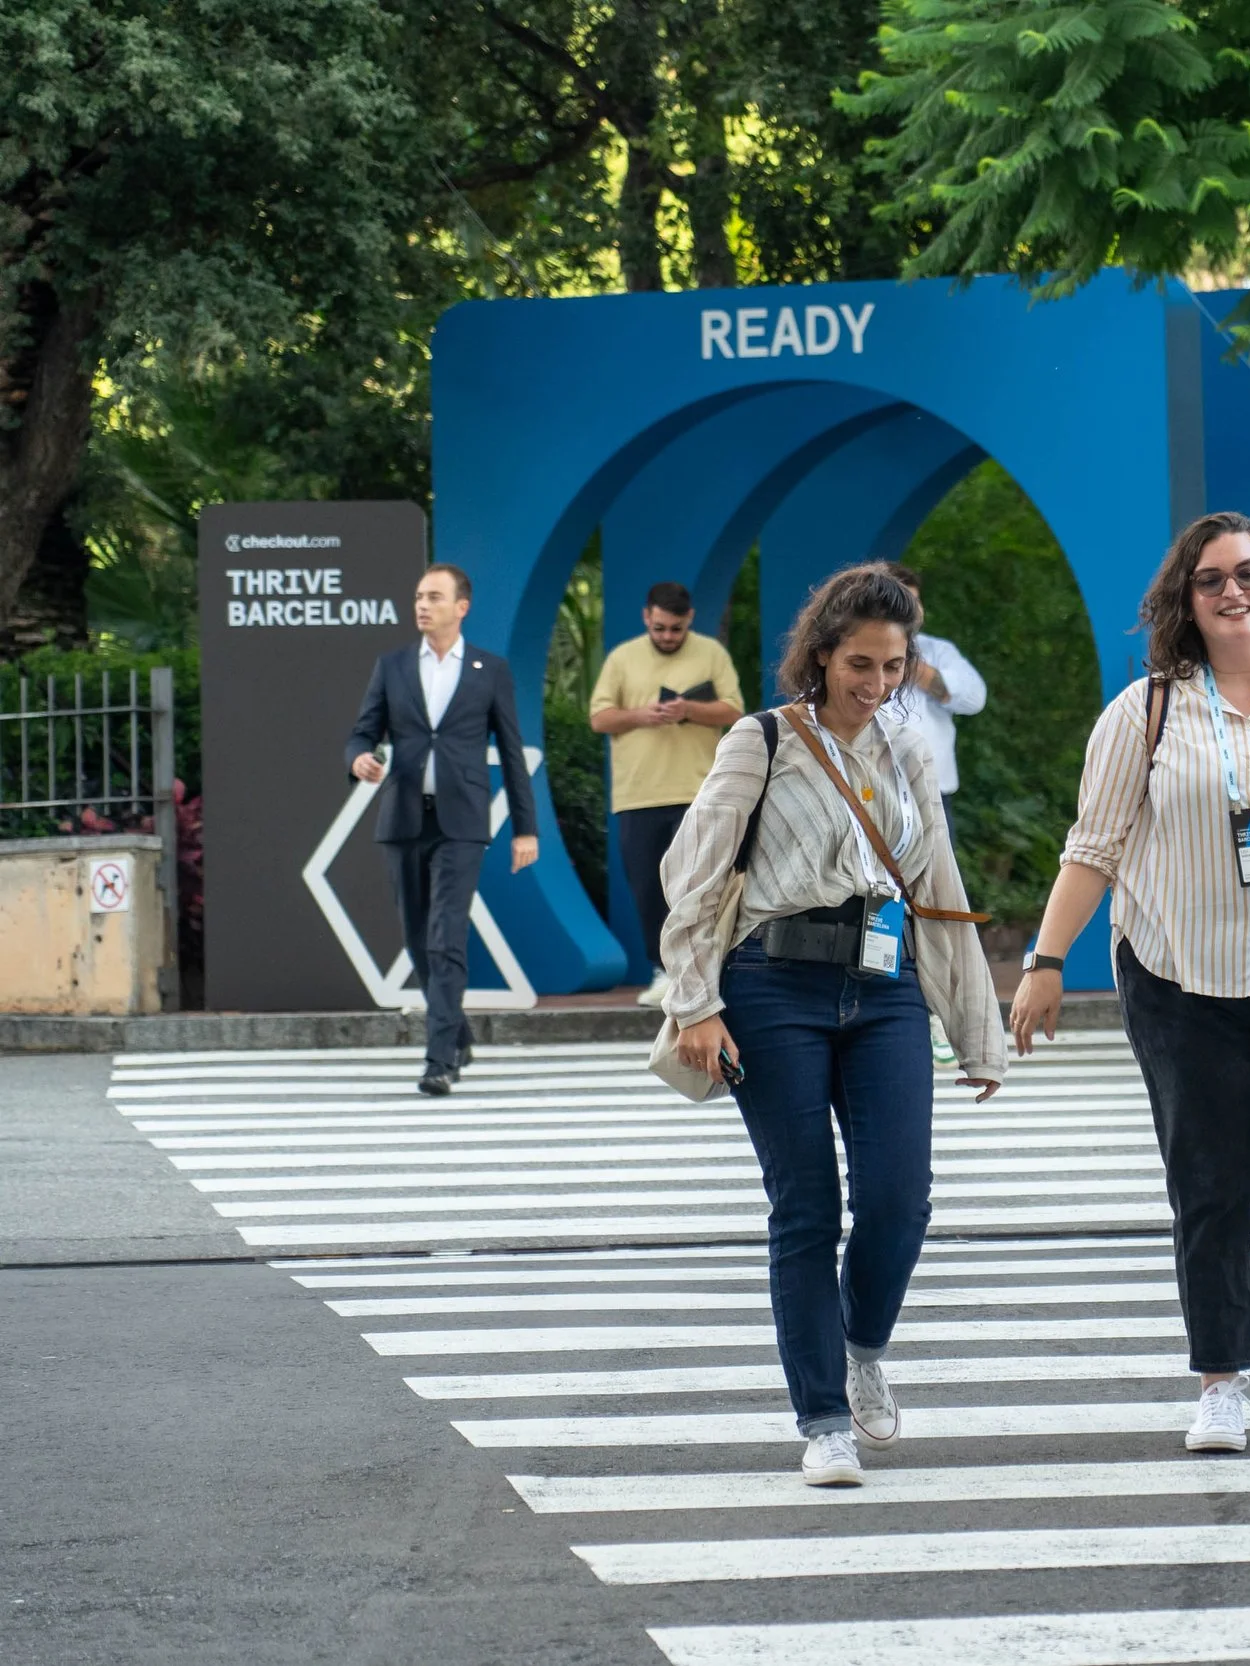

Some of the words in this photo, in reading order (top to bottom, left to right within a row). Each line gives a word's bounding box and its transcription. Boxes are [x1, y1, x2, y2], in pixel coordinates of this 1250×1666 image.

[701, 303, 876, 360] READY
[241, 534, 342, 549] checkout.com
[226, 568, 343, 596] THRIVE
[228, 599, 399, 627] BARCELONA
